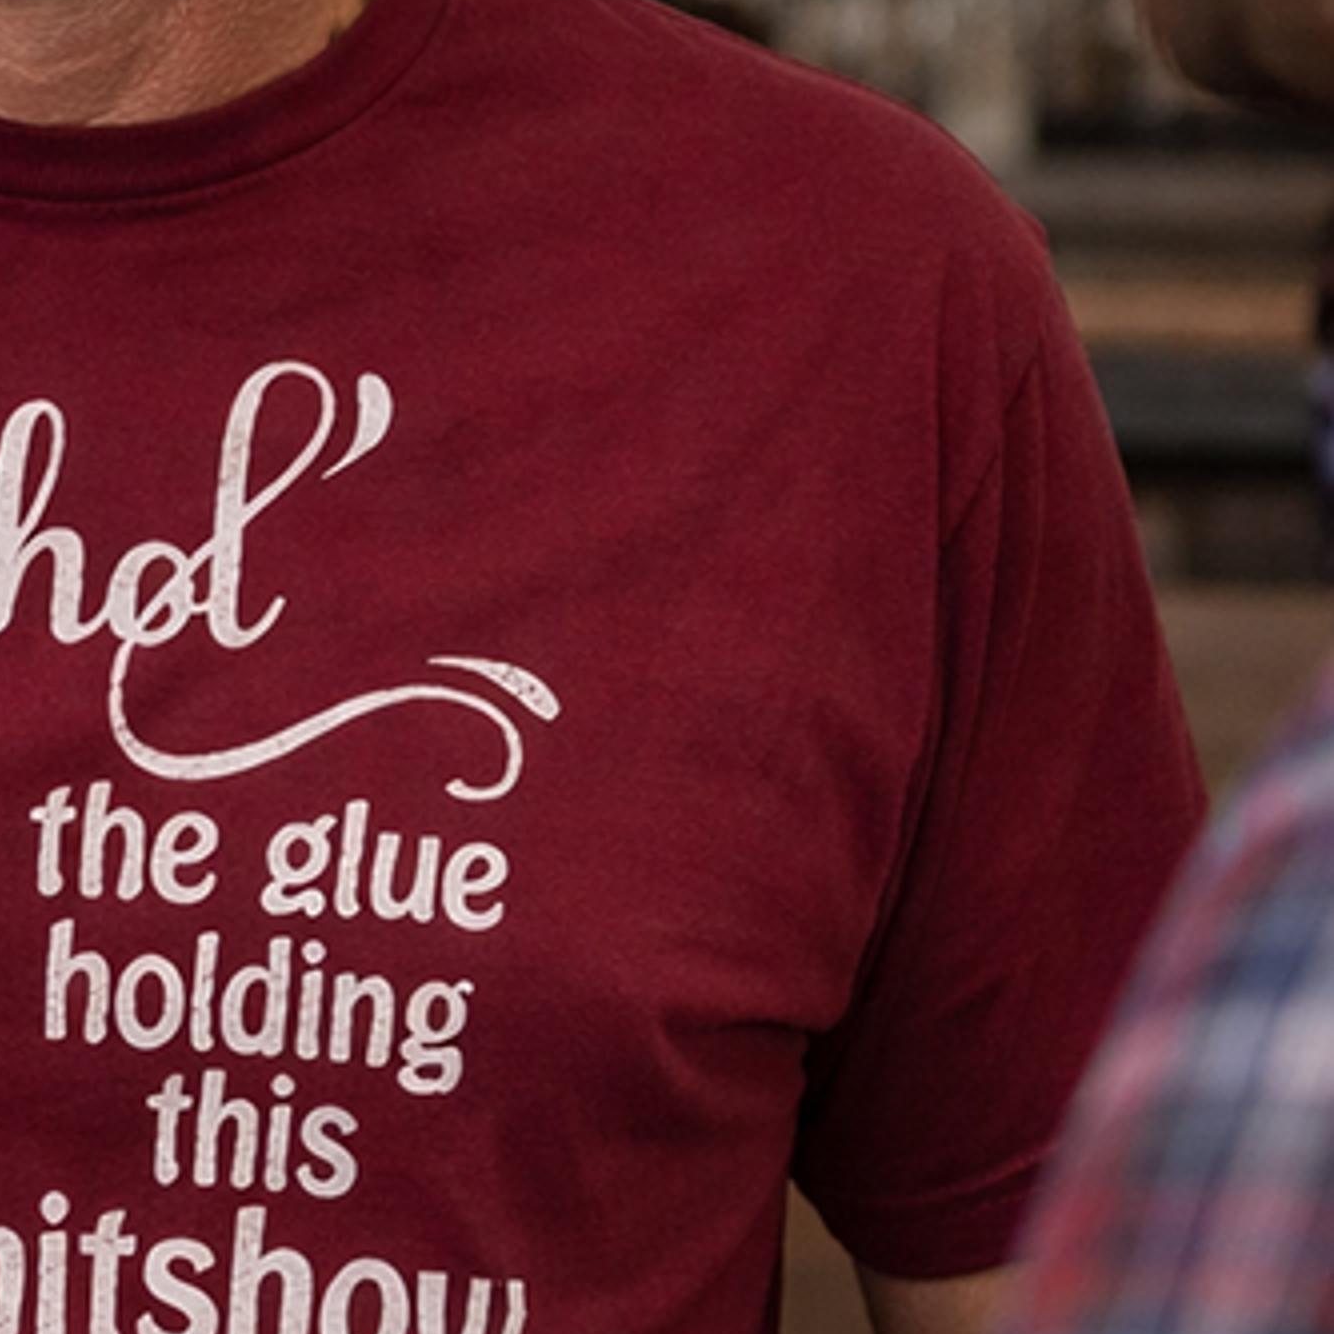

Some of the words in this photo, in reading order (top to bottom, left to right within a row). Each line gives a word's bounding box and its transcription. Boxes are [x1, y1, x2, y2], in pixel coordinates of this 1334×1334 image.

[29, 780, 219, 904] the
[260, 799, 508, 931] glue
[44, 918, 474, 1095] holding
[146, 1069, 359, 1198] this
